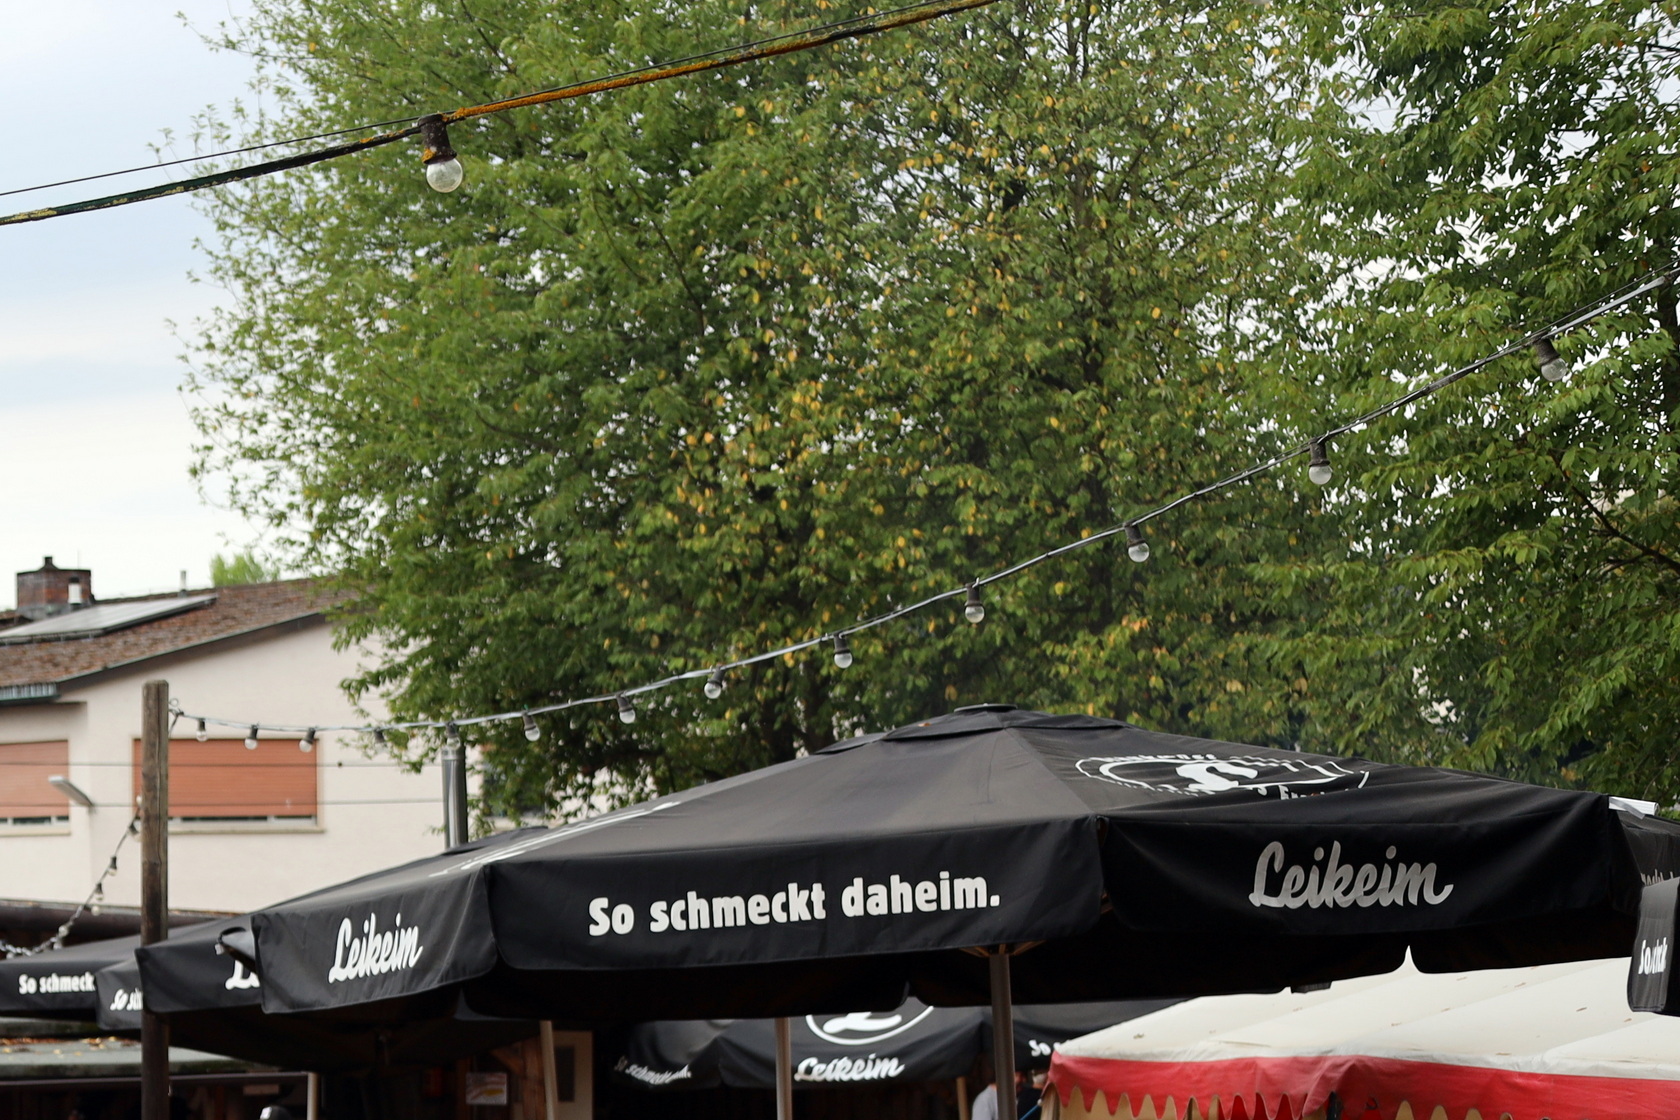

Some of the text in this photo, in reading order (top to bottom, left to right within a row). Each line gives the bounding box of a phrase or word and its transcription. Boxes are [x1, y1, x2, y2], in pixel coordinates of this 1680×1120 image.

[588, 870, 1001, 937] So schmeckt daheim.
[1248, 840, 1454, 909] Leikeim
[328, 913, 423, 983] Leikeim
[18, 971, 96, 995] So schmeck
[793, 1053, 905, 1082] Leikeim
